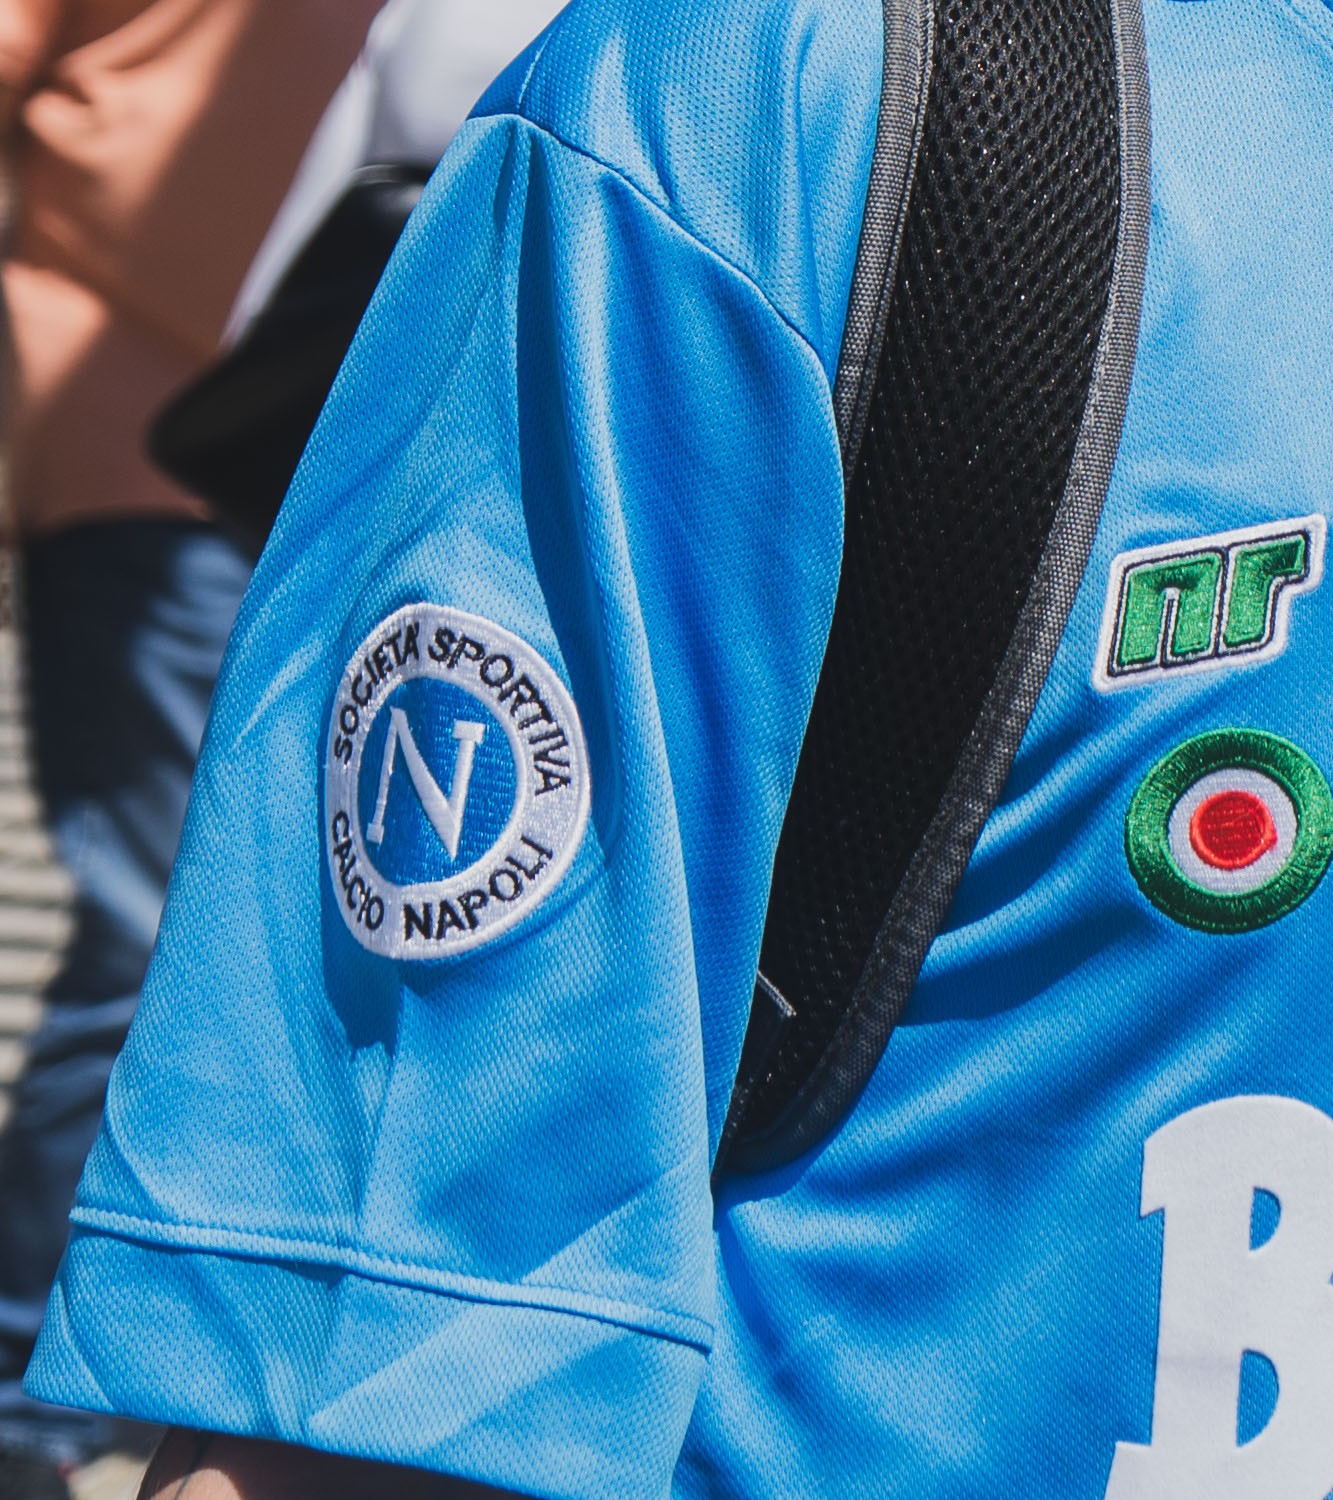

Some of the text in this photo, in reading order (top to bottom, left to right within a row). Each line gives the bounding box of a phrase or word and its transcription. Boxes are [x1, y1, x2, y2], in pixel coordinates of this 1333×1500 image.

[366, 706, 486, 860] N
[428, 627, 571, 796] SPORTIVA
[331, 811, 553, 941] CALCIO NAPOLI
